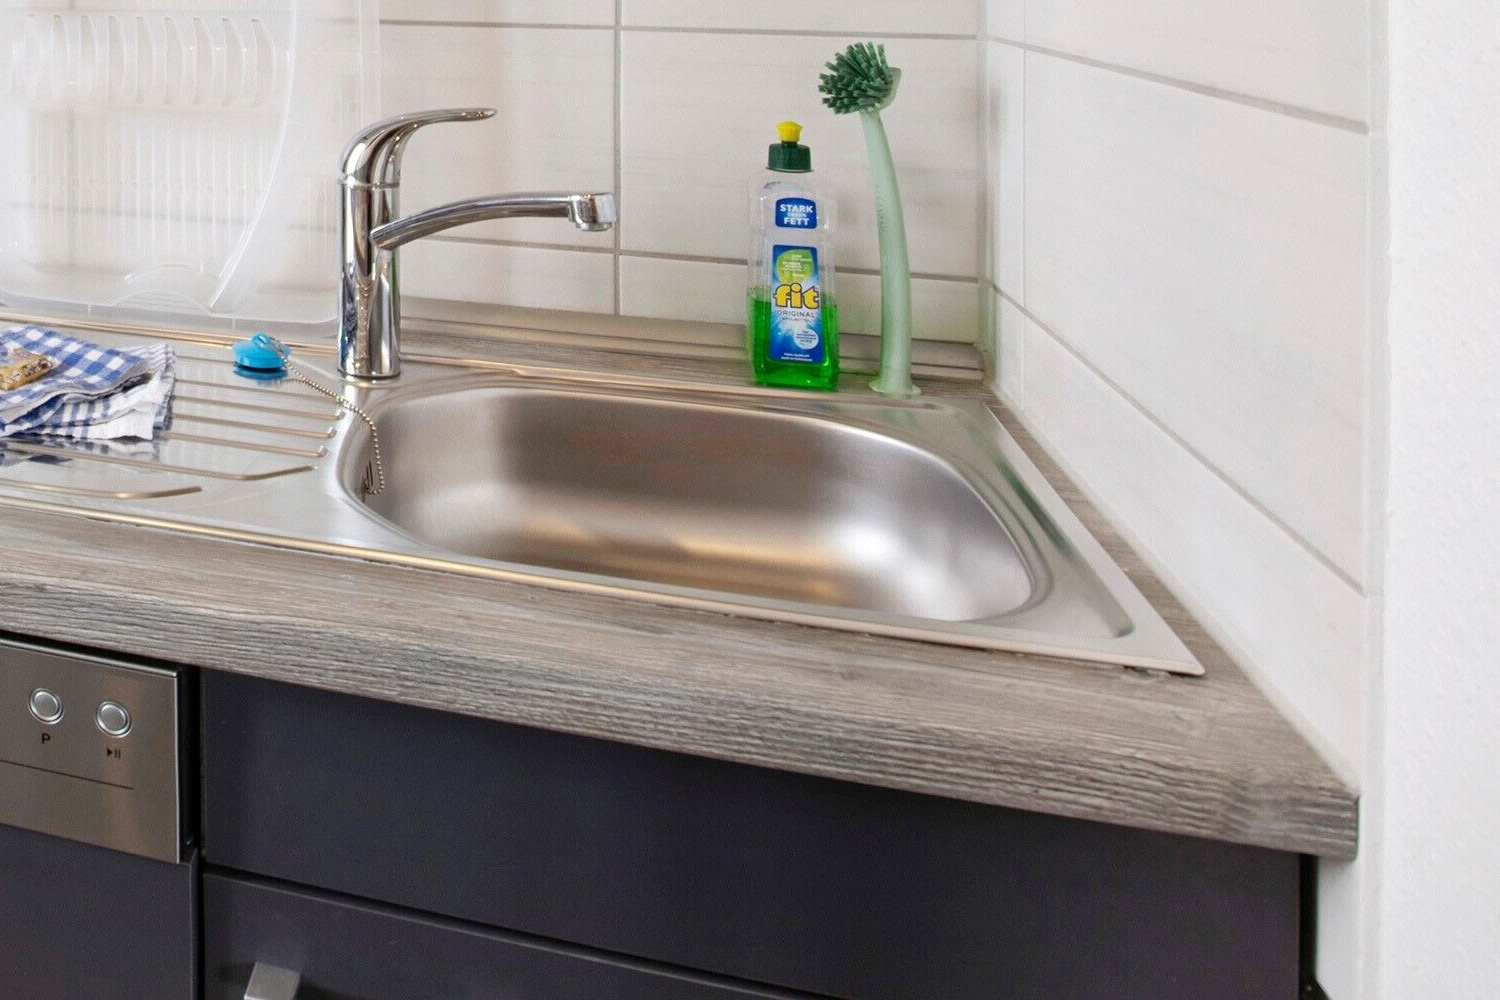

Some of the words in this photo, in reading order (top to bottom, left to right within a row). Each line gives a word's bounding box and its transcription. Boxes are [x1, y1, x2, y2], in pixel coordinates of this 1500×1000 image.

[780, 204, 814, 213] STARK
[783, 217, 810, 226] FETT
[773, 282, 819, 309] fit
[777, 309, 816, 319] ORIGINAL
[41, 732, 51, 744] P
